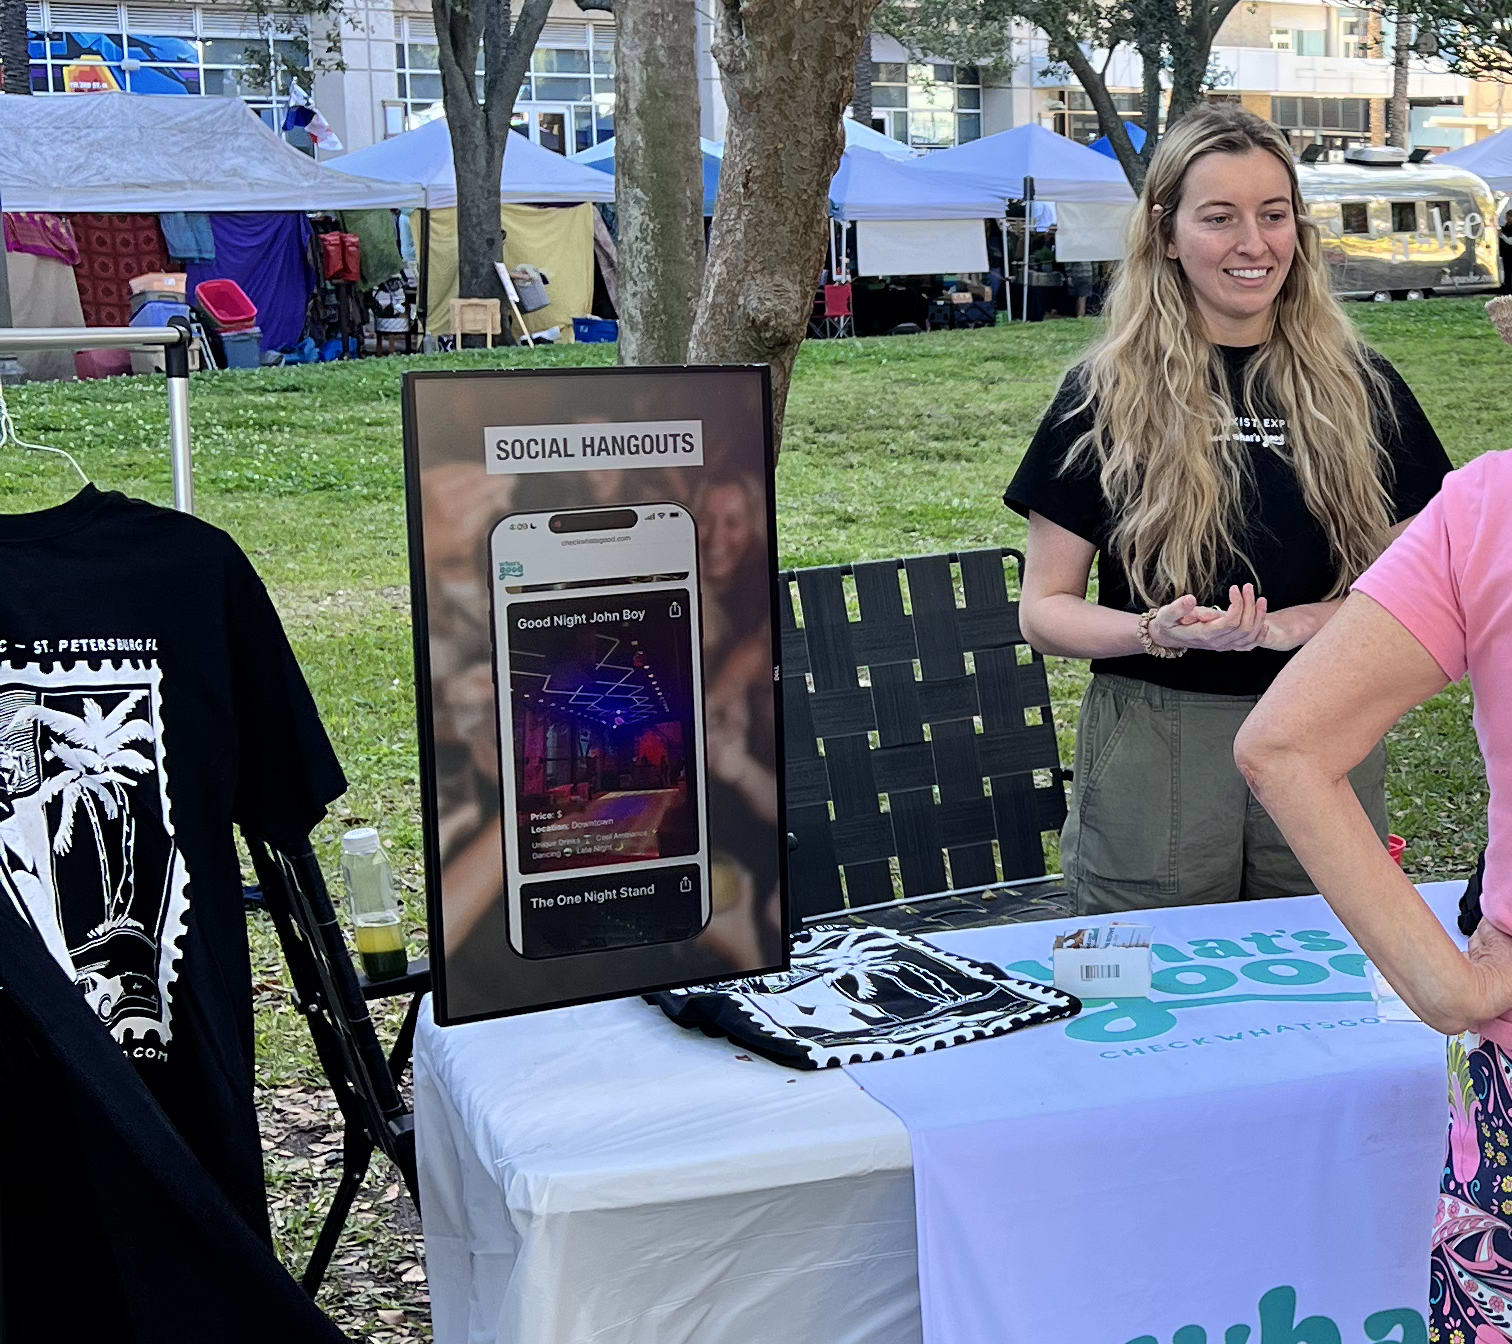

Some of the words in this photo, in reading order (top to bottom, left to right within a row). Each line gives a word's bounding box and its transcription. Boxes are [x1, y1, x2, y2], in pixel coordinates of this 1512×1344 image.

[495, 437, 575, 461] SOCIAL
[581, 432, 695, 458] HANGOUTS
[499, 563, 524, 581] good
[517, 614, 551, 630] Good
[553, 612, 588, 628] Night
[589, 609, 620, 625] John
[622, 608, 646, 624] Boy
[530, 811, 555, 822] Price:
[556, 809, 563, 820] $
[531, 823, 570, 834] Location:
[530, 896, 554, 909] The
[556, 892, 582, 906] One
[584, 888, 618, 904] Night
[619, 883, 655, 898] Stand
[1100, 1016, 1380, 1060] CHECKWHATSGO
